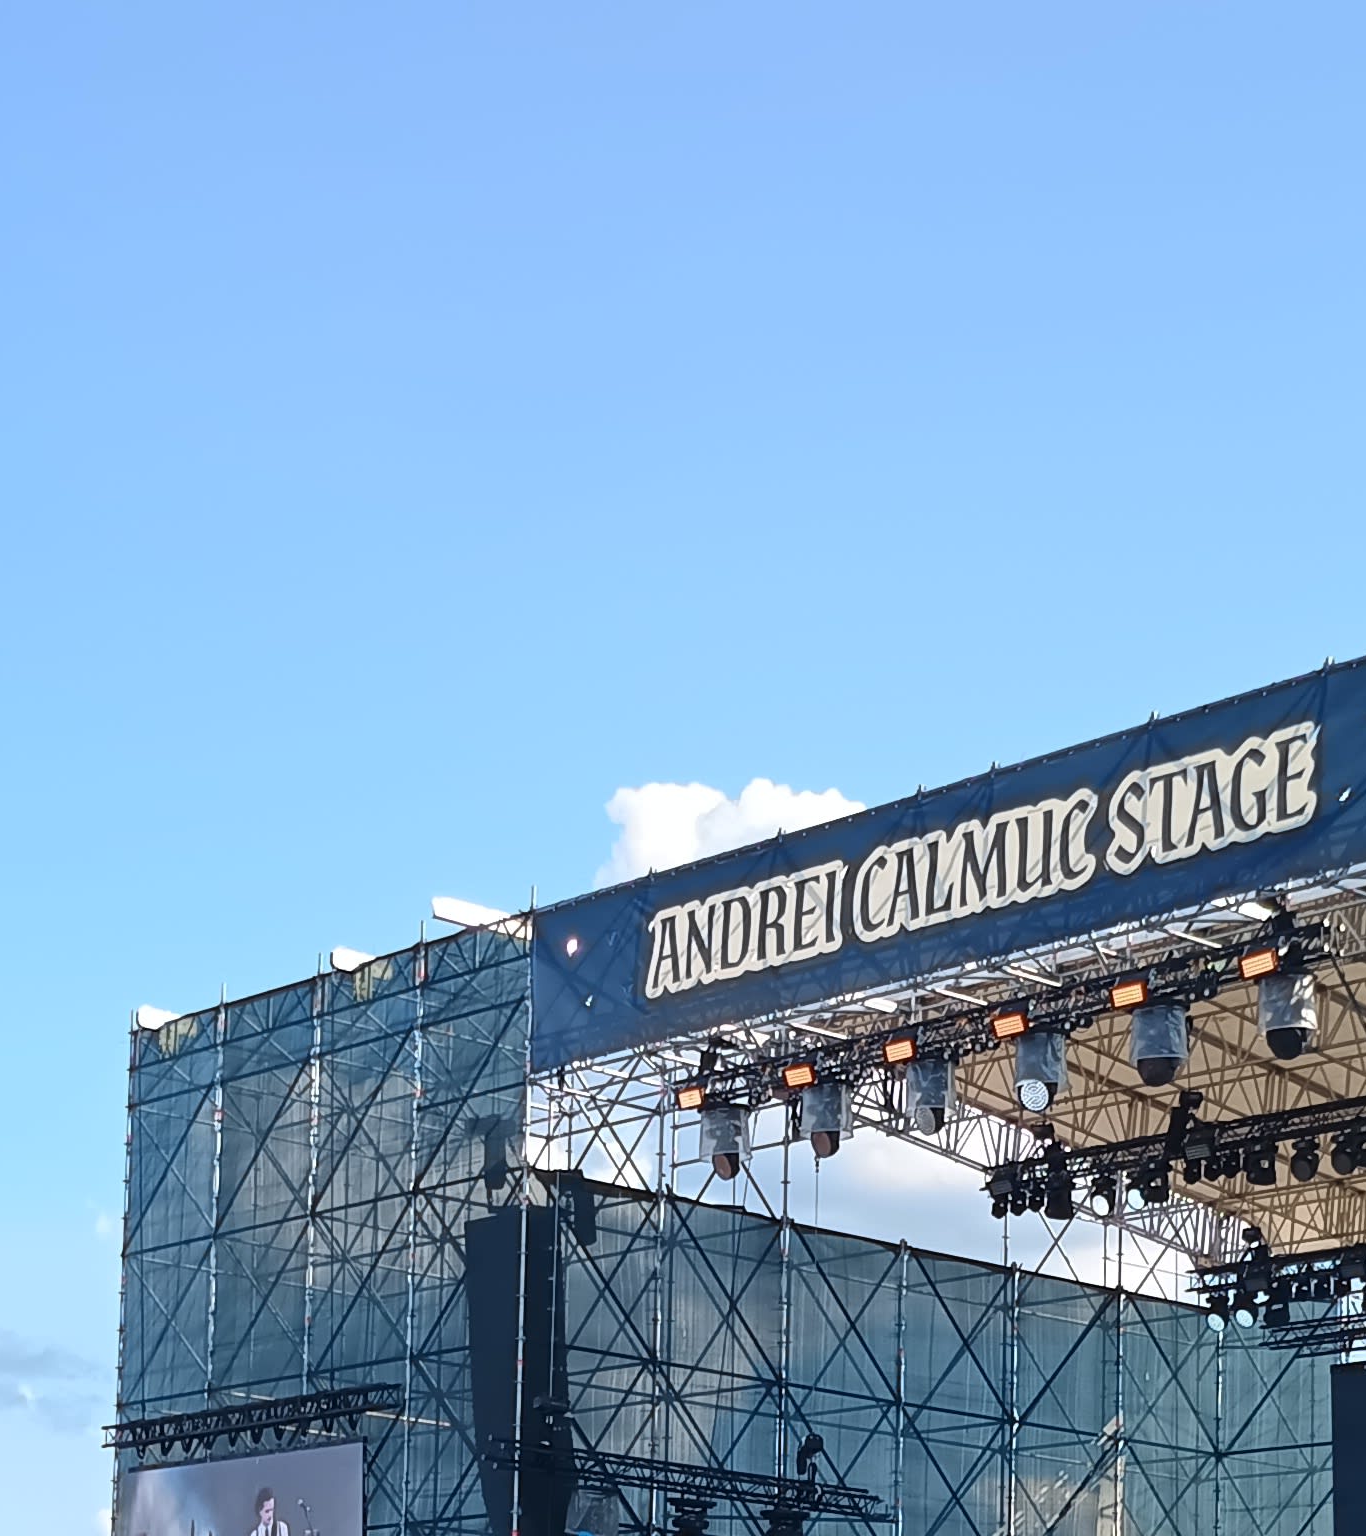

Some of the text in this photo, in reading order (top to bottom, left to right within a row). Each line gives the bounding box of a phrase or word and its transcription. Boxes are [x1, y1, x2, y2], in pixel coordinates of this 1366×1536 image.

[648, 730, 1313, 991] ANDREI CALMUC STAGE
